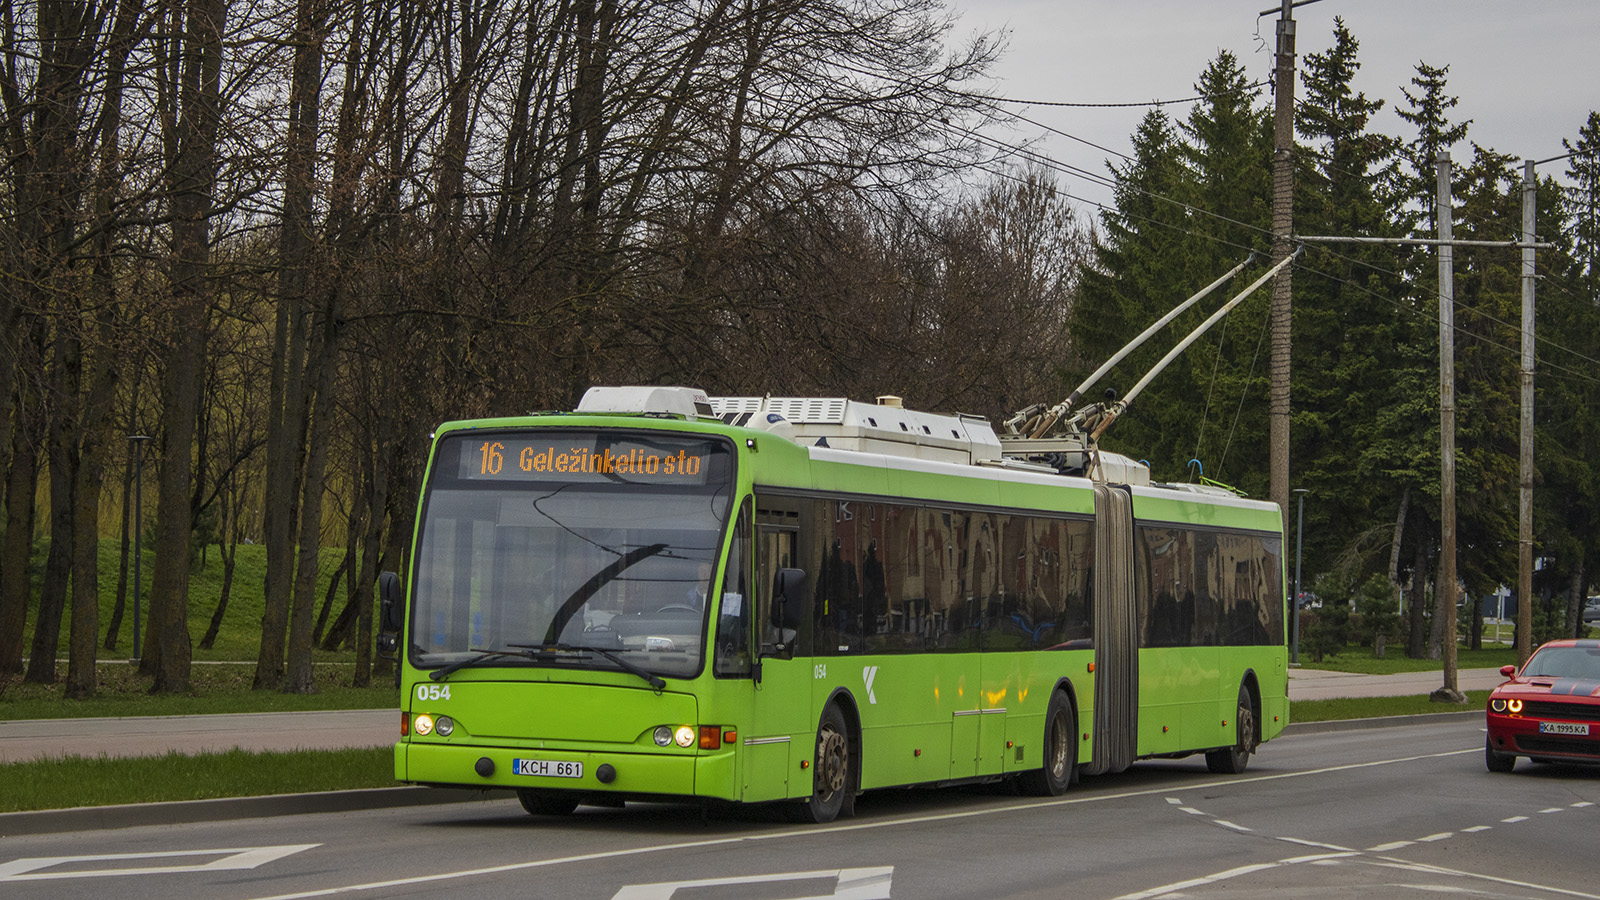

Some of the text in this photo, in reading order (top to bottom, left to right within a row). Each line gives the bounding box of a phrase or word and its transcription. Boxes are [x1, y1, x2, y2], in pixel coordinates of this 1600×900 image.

[480, 442, 700, 476] 16 Geležinkelio sto
[814, 664, 827, 679] 054
[417, 685, 451, 701] 054
[1543, 724, 1586, 734] KA 1995 KA
[521, 761, 549, 774] KCH
[557, 763, 579, 776] 661
